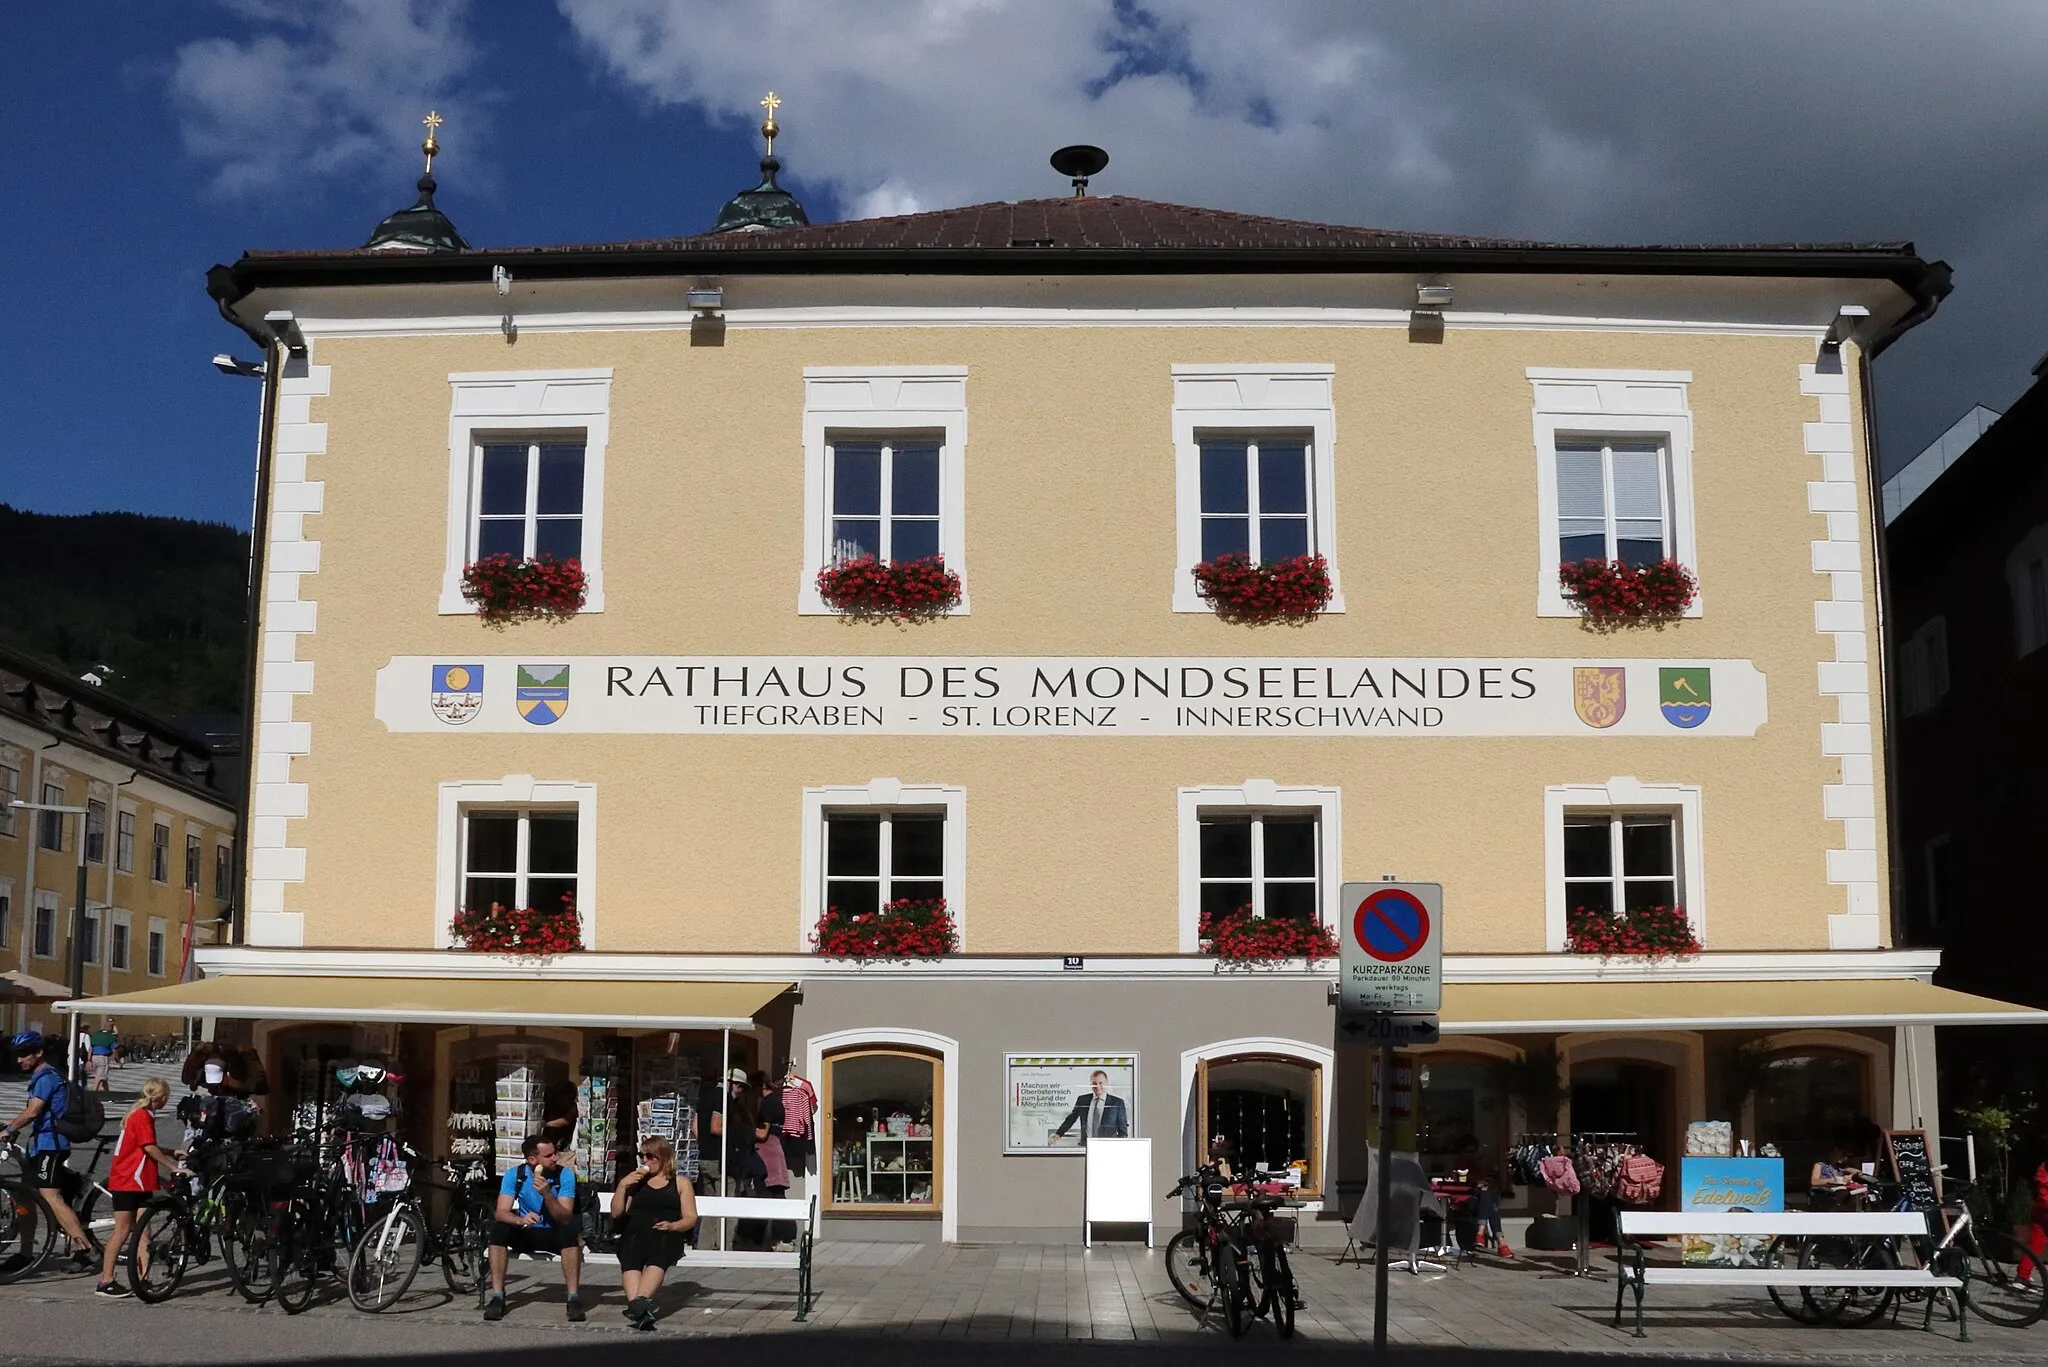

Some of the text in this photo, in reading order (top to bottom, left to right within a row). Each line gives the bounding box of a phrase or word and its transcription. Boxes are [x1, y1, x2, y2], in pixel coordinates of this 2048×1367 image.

[606, 666, 1537, 699] RATHAUS DES MONDSEELANDES
[694, 705, 885, 726] TIEFGRABEN
[941, 705, 981, 727] ST.
[993, 706, 1117, 727] LORENZ
[1176, 706, 1444, 728] INNERSCHWAND
[1352, 965, 1431, 975] KURZPARKZONE
[1375, 984, 1409, 992] werktags
[1360, 1000, 1391, 1008] Samstag
[1368, 1017, 1410, 1039] 20 m
[1691, 1187, 1773, 1206] Edelweiß
